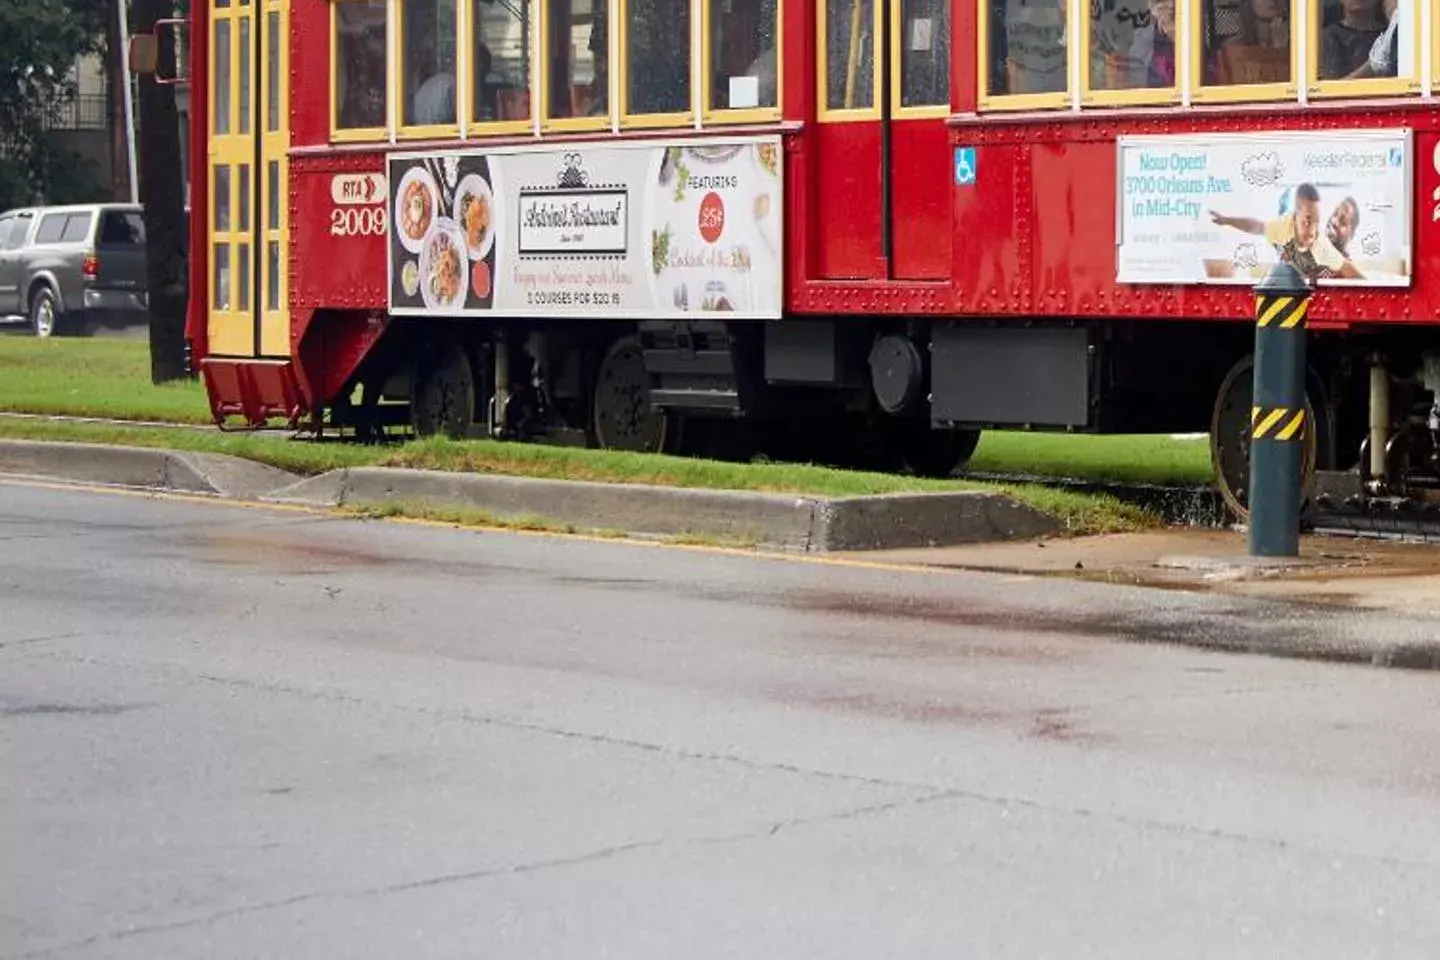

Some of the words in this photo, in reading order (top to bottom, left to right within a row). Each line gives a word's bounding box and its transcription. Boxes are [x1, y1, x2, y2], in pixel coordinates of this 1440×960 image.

[1139, 152, 1168, 171] Now
[1170, 152, 1207, 175] Open!
[343, 180, 362, 197] RTA
[688, 175, 738, 189] FEATURING
[331, 207, 387, 236] 2009
